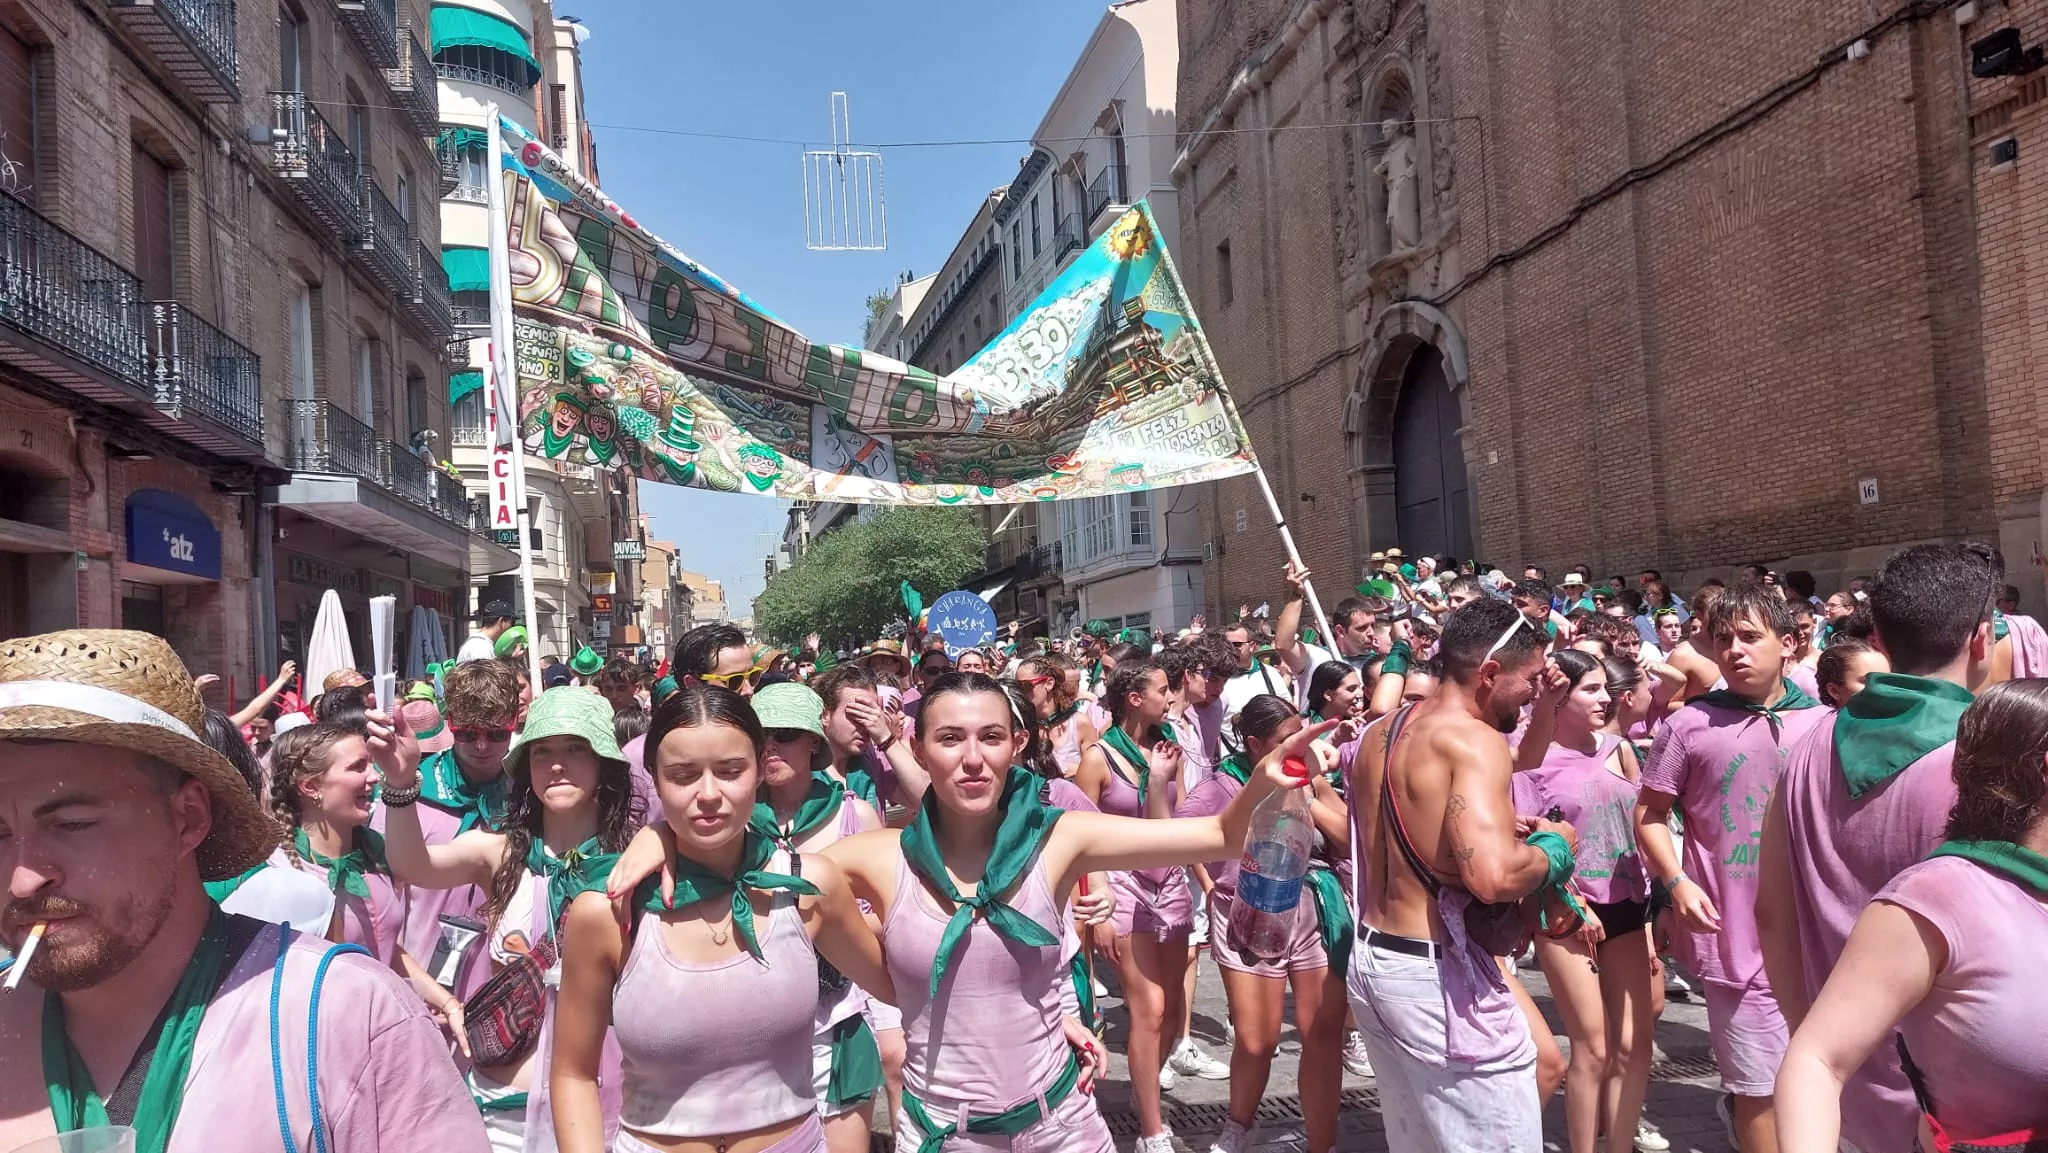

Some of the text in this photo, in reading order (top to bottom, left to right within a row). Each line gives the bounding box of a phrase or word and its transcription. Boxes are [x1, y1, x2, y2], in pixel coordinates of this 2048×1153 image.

[1863, 484, 1875, 499] 16
[170, 532, 194, 562] atz
[614, 541, 641, 554] DUVISA
